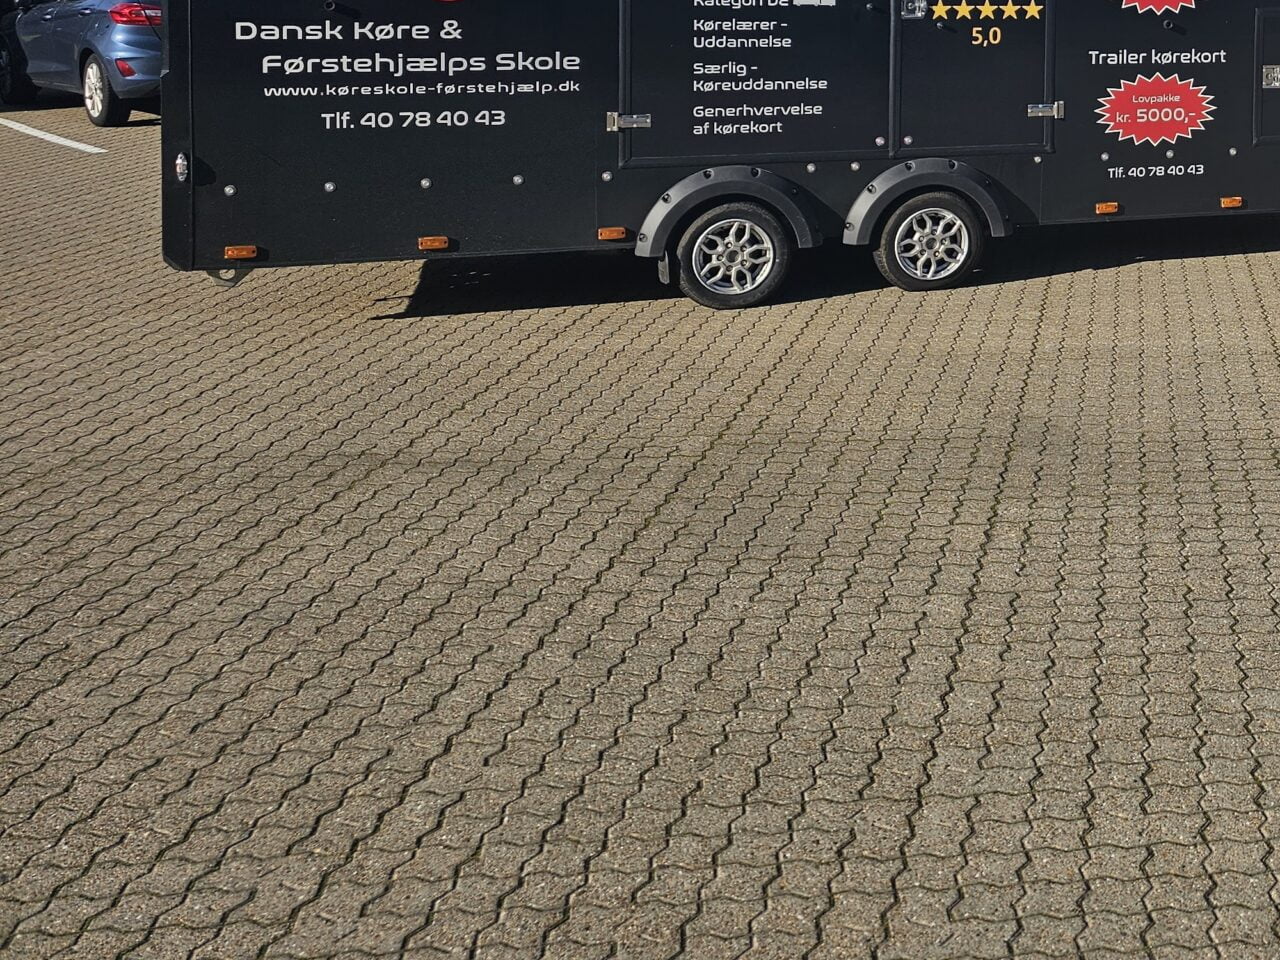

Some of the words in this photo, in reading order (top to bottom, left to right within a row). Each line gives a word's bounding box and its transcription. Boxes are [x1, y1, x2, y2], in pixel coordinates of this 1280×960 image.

[236, 20, 343, 39] Dansk
[354, 22, 429, 40] Køre
[440, 20, 462, 39] &
[694, 19, 777, 31] Kørelærer
[694, 35, 791, 47] Uddannelse
[970, 26, 1002, 48] 5,0
[1089, 49, 1147, 64] Trailer
[1152, 49, 1226, 64] kørekort
[263, 52, 485, 76] Førstehjælps
[496, 52, 580, 70] Skole
[694, 62, 746, 76] Særlig
[264, 81, 579, 96] www.køreskole-førstehjælp.dk
[694, 78, 827, 92] Køreuddannelse
[1133, 94, 1180, 104] Lovpakke
[693, 103, 822, 117] Generhvervelse
[1116, 112, 1131, 122] kr.
[1137, 108, 1195, 123] 5000,-
[321, 112, 354, 129] Tlf.
[360, 113, 393, 127] 40
[399, 112, 430, 127] 78
[437, 111, 468, 126] 40
[475, 111, 505, 125] 43
[693, 122, 709, 134] af
[714, 121, 782, 134] kørekort
[1108, 167, 1125, 178] Tlf.
[1128, 167, 1145, 177] 40
[1148, 166, 1164, 176] 78
[1167, 166, 1184, 175] 40
[1187, 165, 1203, 174] 43
